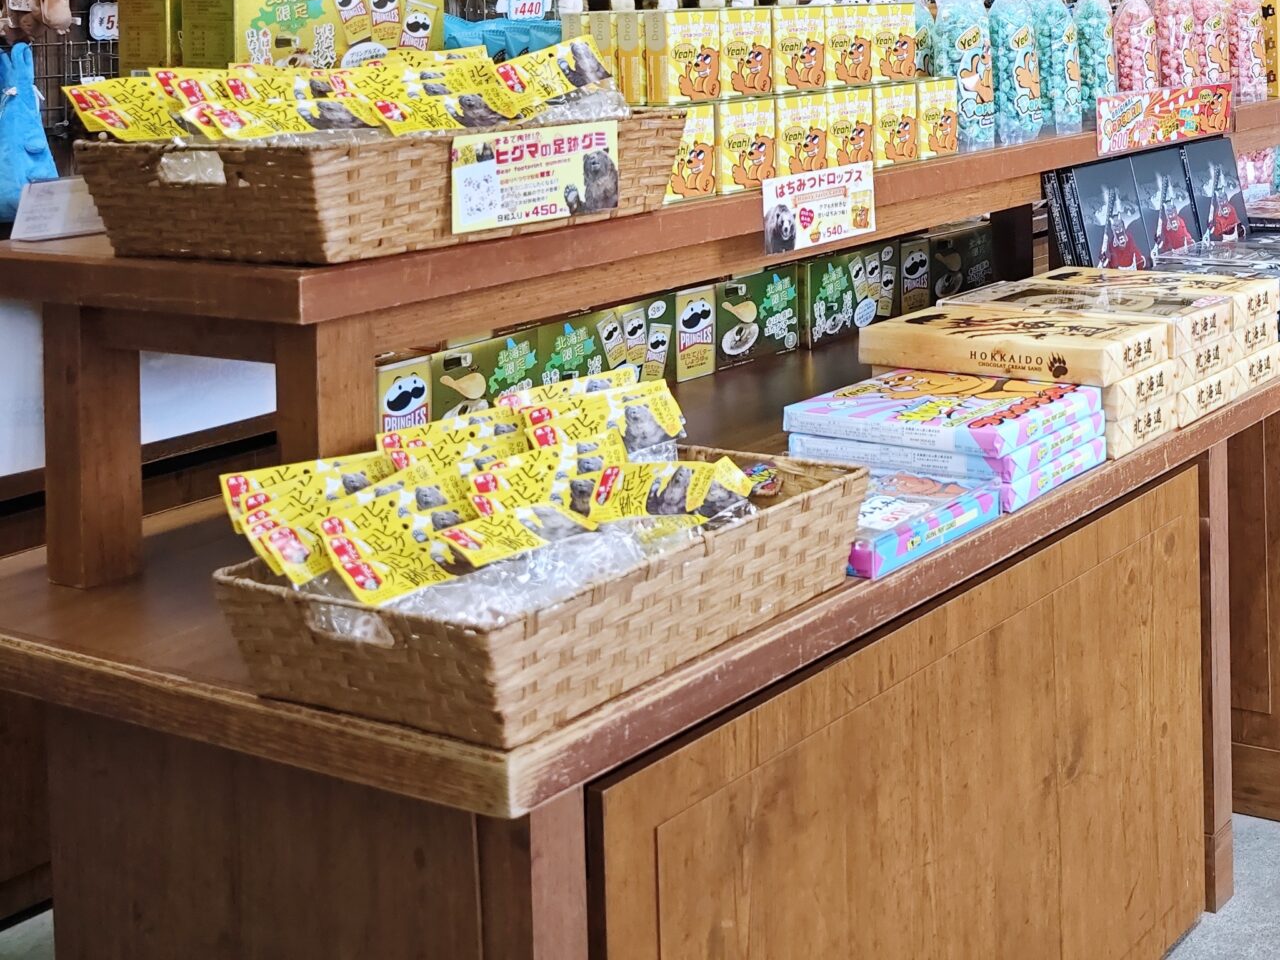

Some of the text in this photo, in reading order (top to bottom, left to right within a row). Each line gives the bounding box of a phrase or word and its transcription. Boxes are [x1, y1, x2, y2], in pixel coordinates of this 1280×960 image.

[275, 4, 310, 22] 限定
[372, 8, 400, 25] PRINGLES
[514, 1, 542, 17] ¥440
[400, 32, 428, 49] PRINGLES
[780, 41, 802, 52] Yeah!
[830, 38, 850, 47] Yeah!
[875, 35, 895, 45] Yeah!
[673, 48, 696, 59] Yeah!
[726, 45, 748, 56] Yeah!
[832, 124, 851, 134] Yeah!
[880, 118, 898, 129] Yeah!
[727, 139, 750, 150] Yeah!
[784, 131, 805, 142] Yeah!
[495, 132, 607, 165] ヒグマの足跡グミ
[775, 169, 862, 198] はちみつドロップス
[525, 203, 558, 218] ¥450
[822, 225, 843, 238] ¥540
[903, 276, 928, 292] PRINGLES
[1248, 291, 1269, 313] 北海道
[1192, 313, 1217, 336] 北海道
[1245, 322, 1267, 344] 北海道
[555, 326, 589, 351] 北海道
[680, 327, 712, 350] PRINGLES
[499, 341, 530, 365] 北海道
[562, 344, 584, 362] 限定
[969, 350, 1044, 366] HOKKAIDO
[1123, 337, 1152, 362] 北海道
[1196, 345, 1220, 369] 北海道
[505, 359, 526, 376] 限定
[978, 361, 1007, 370] CHOCOLAT
[1008, 363, 1026, 371] CREAM
[1249, 354, 1272, 377] 北海道
[1137, 370, 1164, 395] 北海道
[1198, 380, 1223, 402] 北海道
[384, 406, 427, 433] PRINGLES
[1133, 407, 1162, 434] 北海道
[392, 548, 447, 581] ヒグマの
